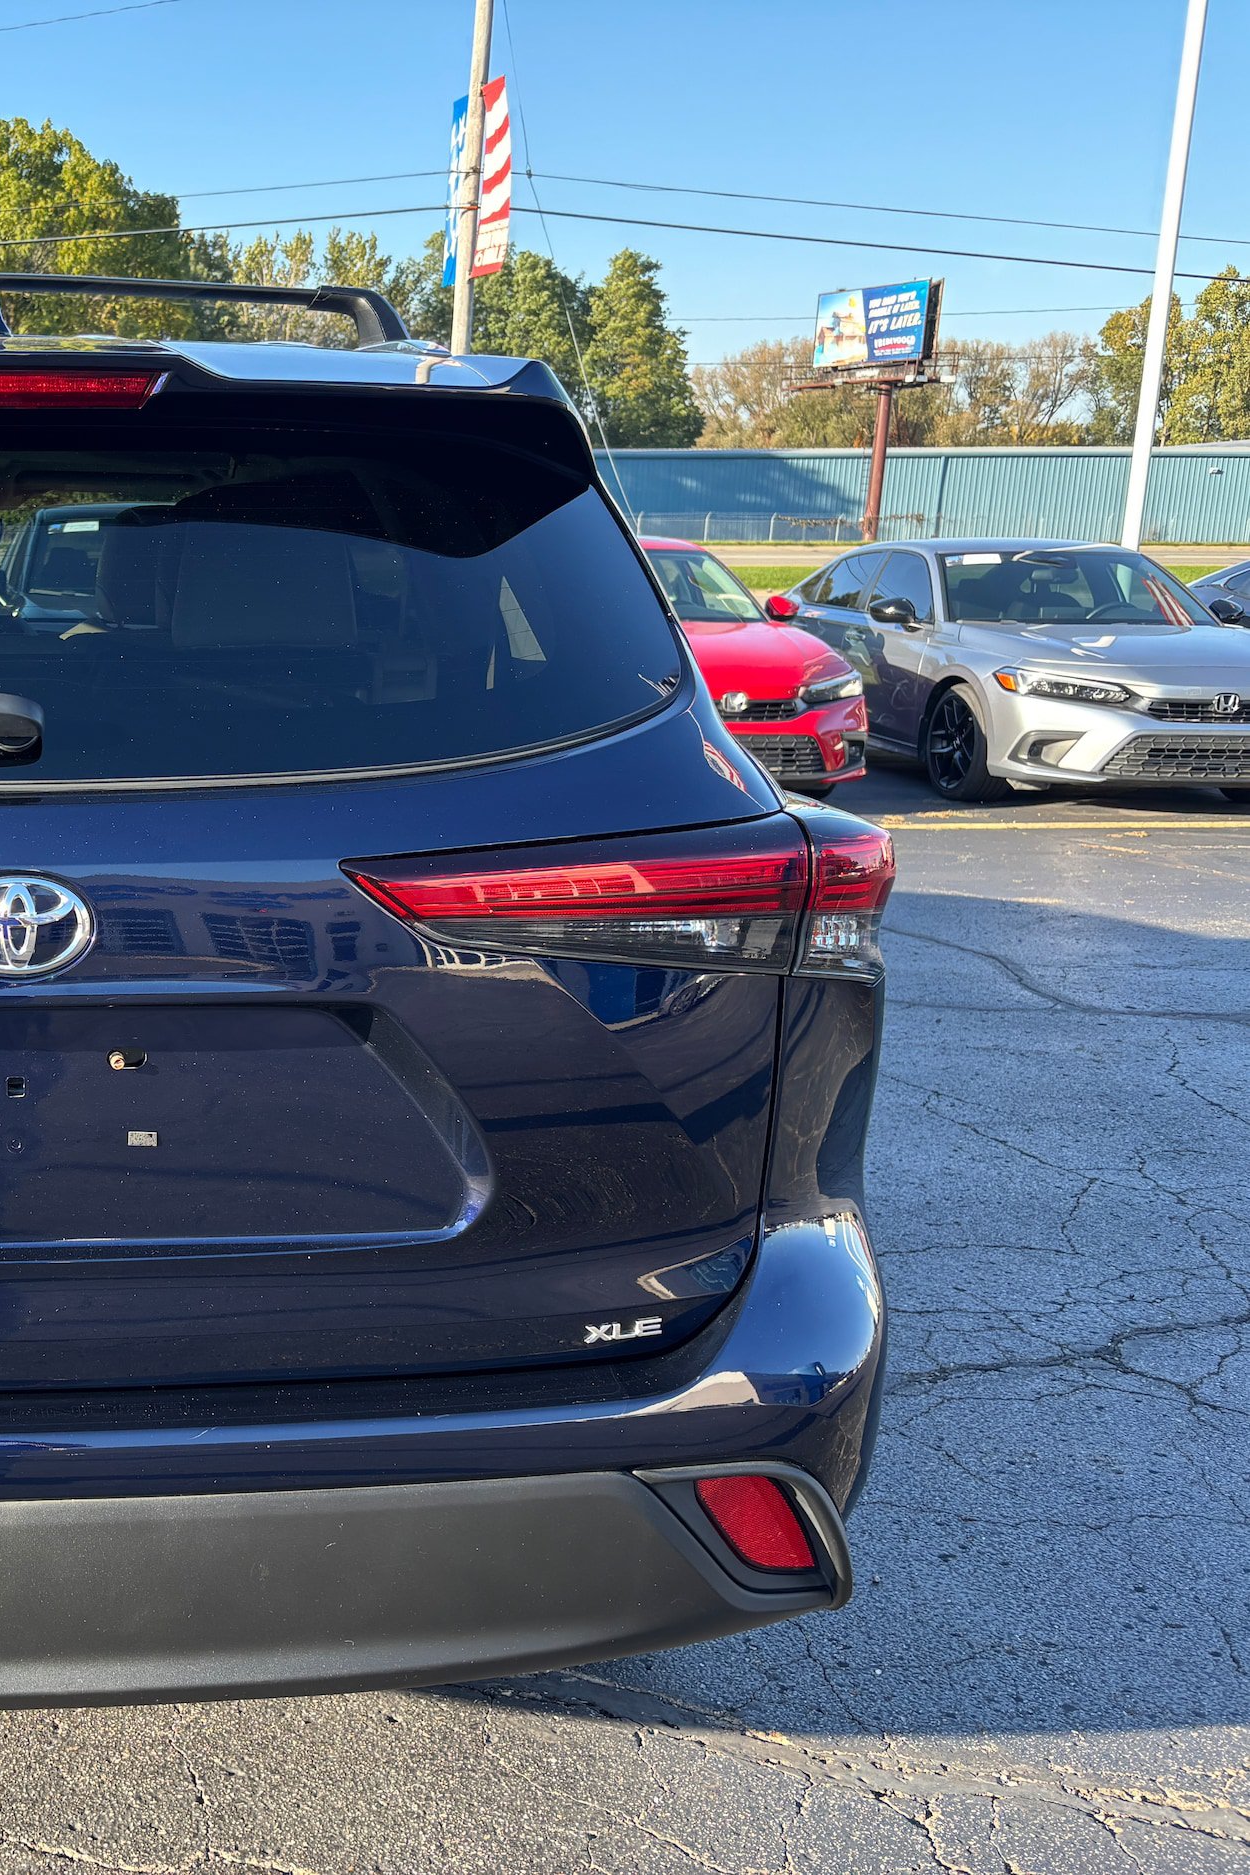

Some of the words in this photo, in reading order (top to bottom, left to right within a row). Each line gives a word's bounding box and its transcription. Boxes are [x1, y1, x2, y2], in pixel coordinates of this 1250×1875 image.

[867, 318, 889, 334] IT'S
[890, 312, 922, 330] LATER.
[584, 1316, 663, 1344] XLE
